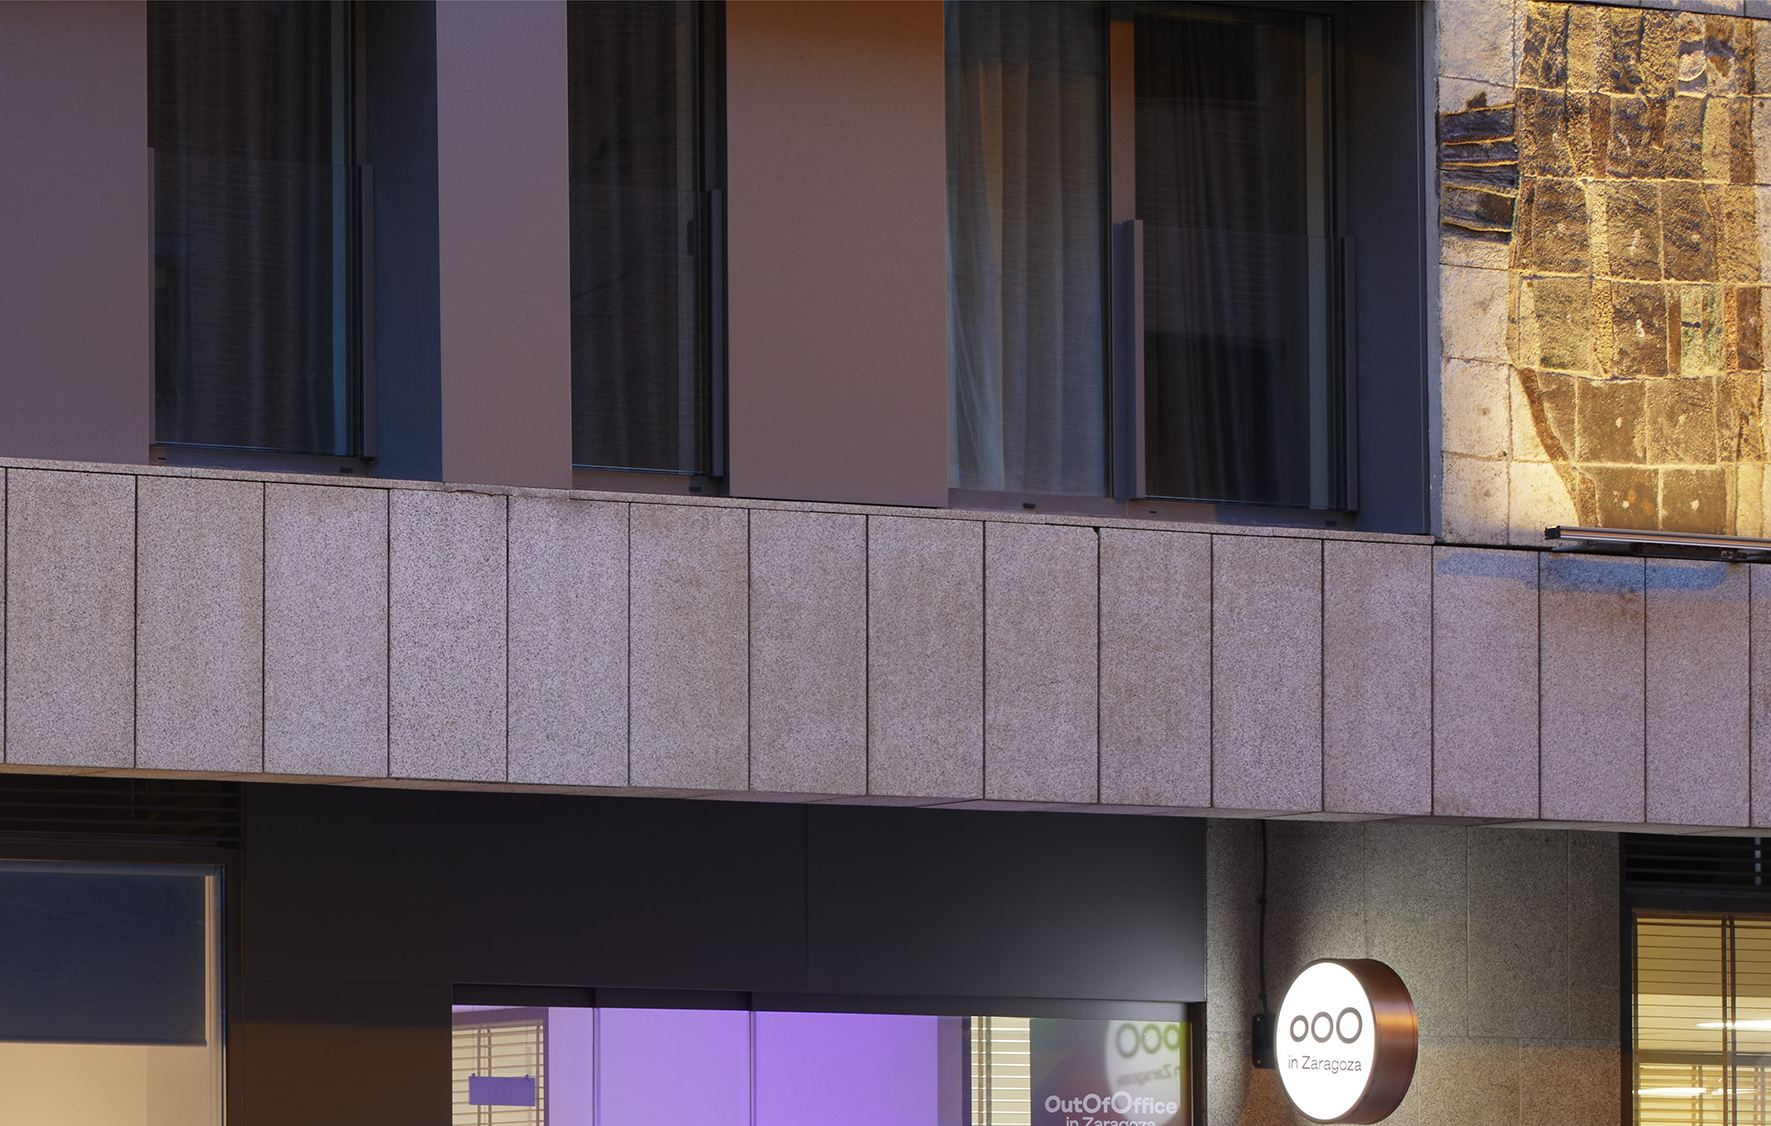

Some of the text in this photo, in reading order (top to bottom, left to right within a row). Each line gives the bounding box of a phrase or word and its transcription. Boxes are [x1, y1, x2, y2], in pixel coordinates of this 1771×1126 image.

[1288, 1055, 1363, 1074] in Zaragoza
[1044, 1090, 1178, 1114] OutOfOffice
